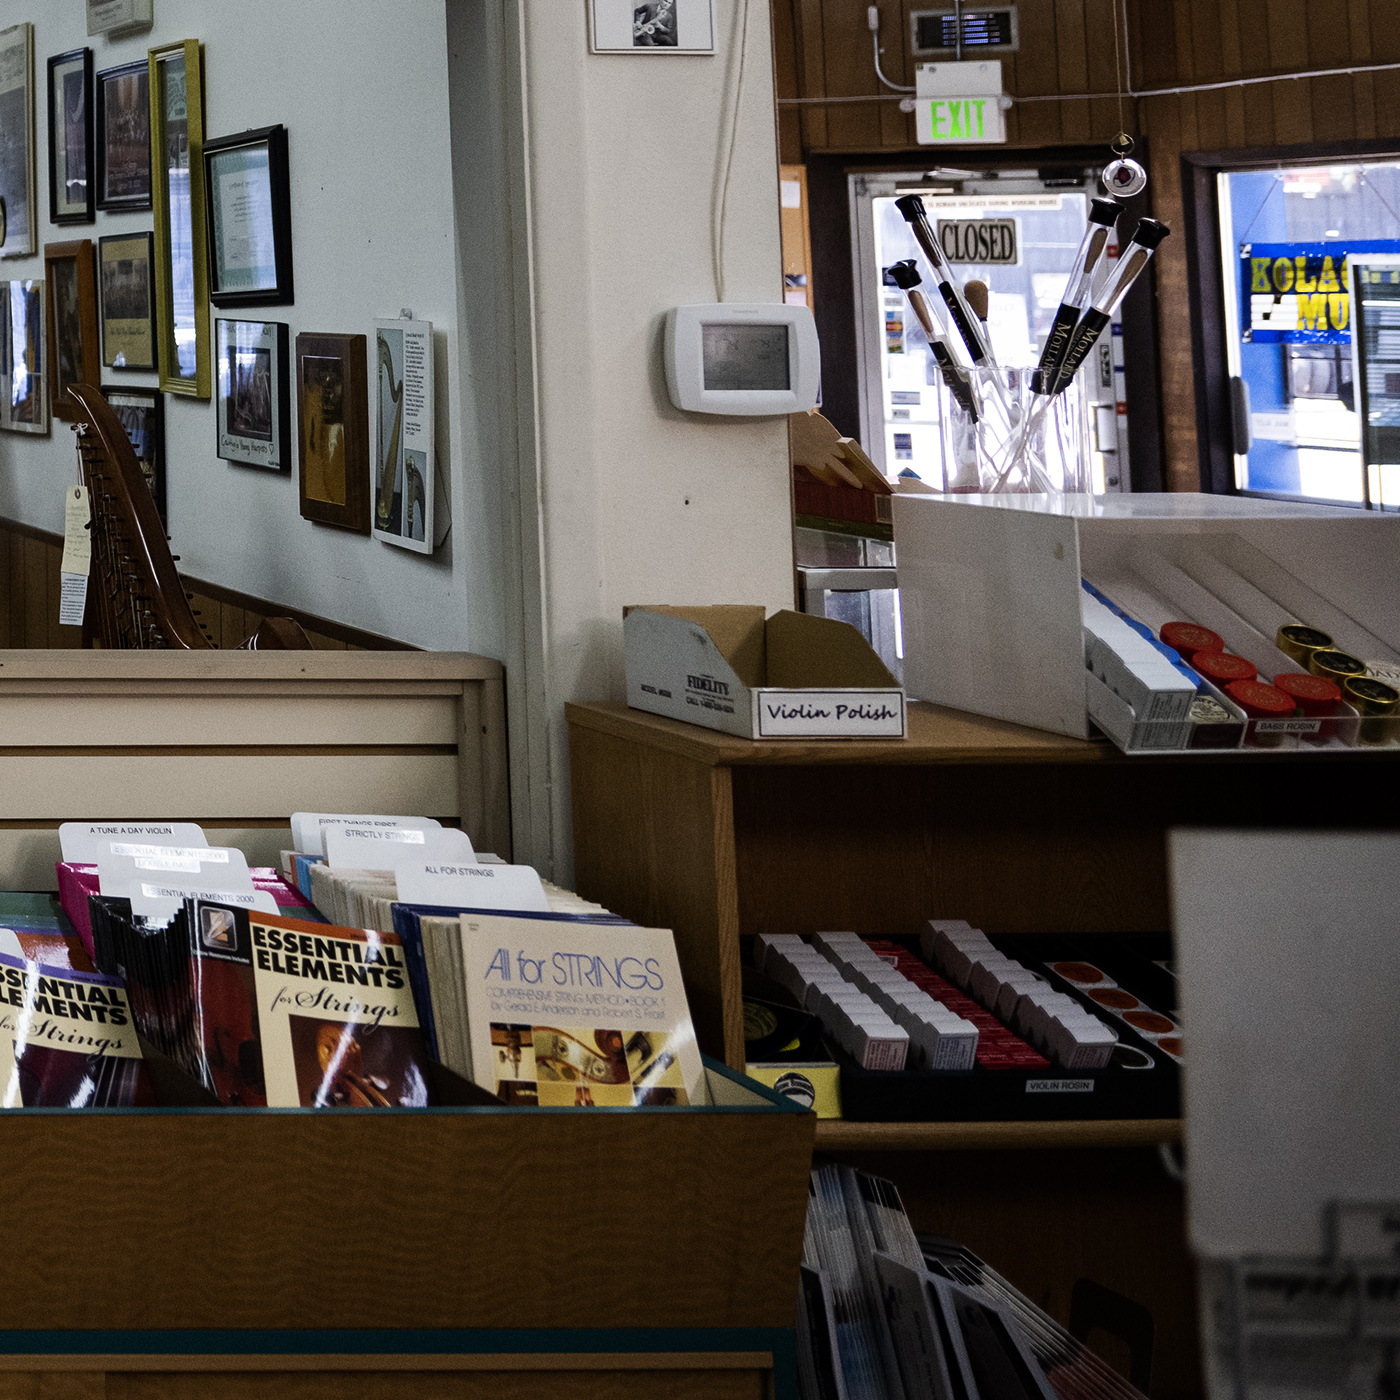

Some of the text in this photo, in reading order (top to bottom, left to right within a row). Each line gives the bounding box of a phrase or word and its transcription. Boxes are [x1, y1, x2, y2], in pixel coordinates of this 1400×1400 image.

[931, 99, 987, 139] EXIT
[942, 223, 1015, 262] CLOSED
[686, 676, 729, 696] FIDELITY
[767, 702, 898, 723] Violin Polish
[1260, 722, 1315, 732] BASS ROSIN
[252, 926, 404, 967] ESSENTIAL
[257, 948, 404, 988] ELEMENTS
[485, 948, 663, 991] All for STRINGS
[1030, 1081, 1090, 1090] VIOLIN ROSIN
